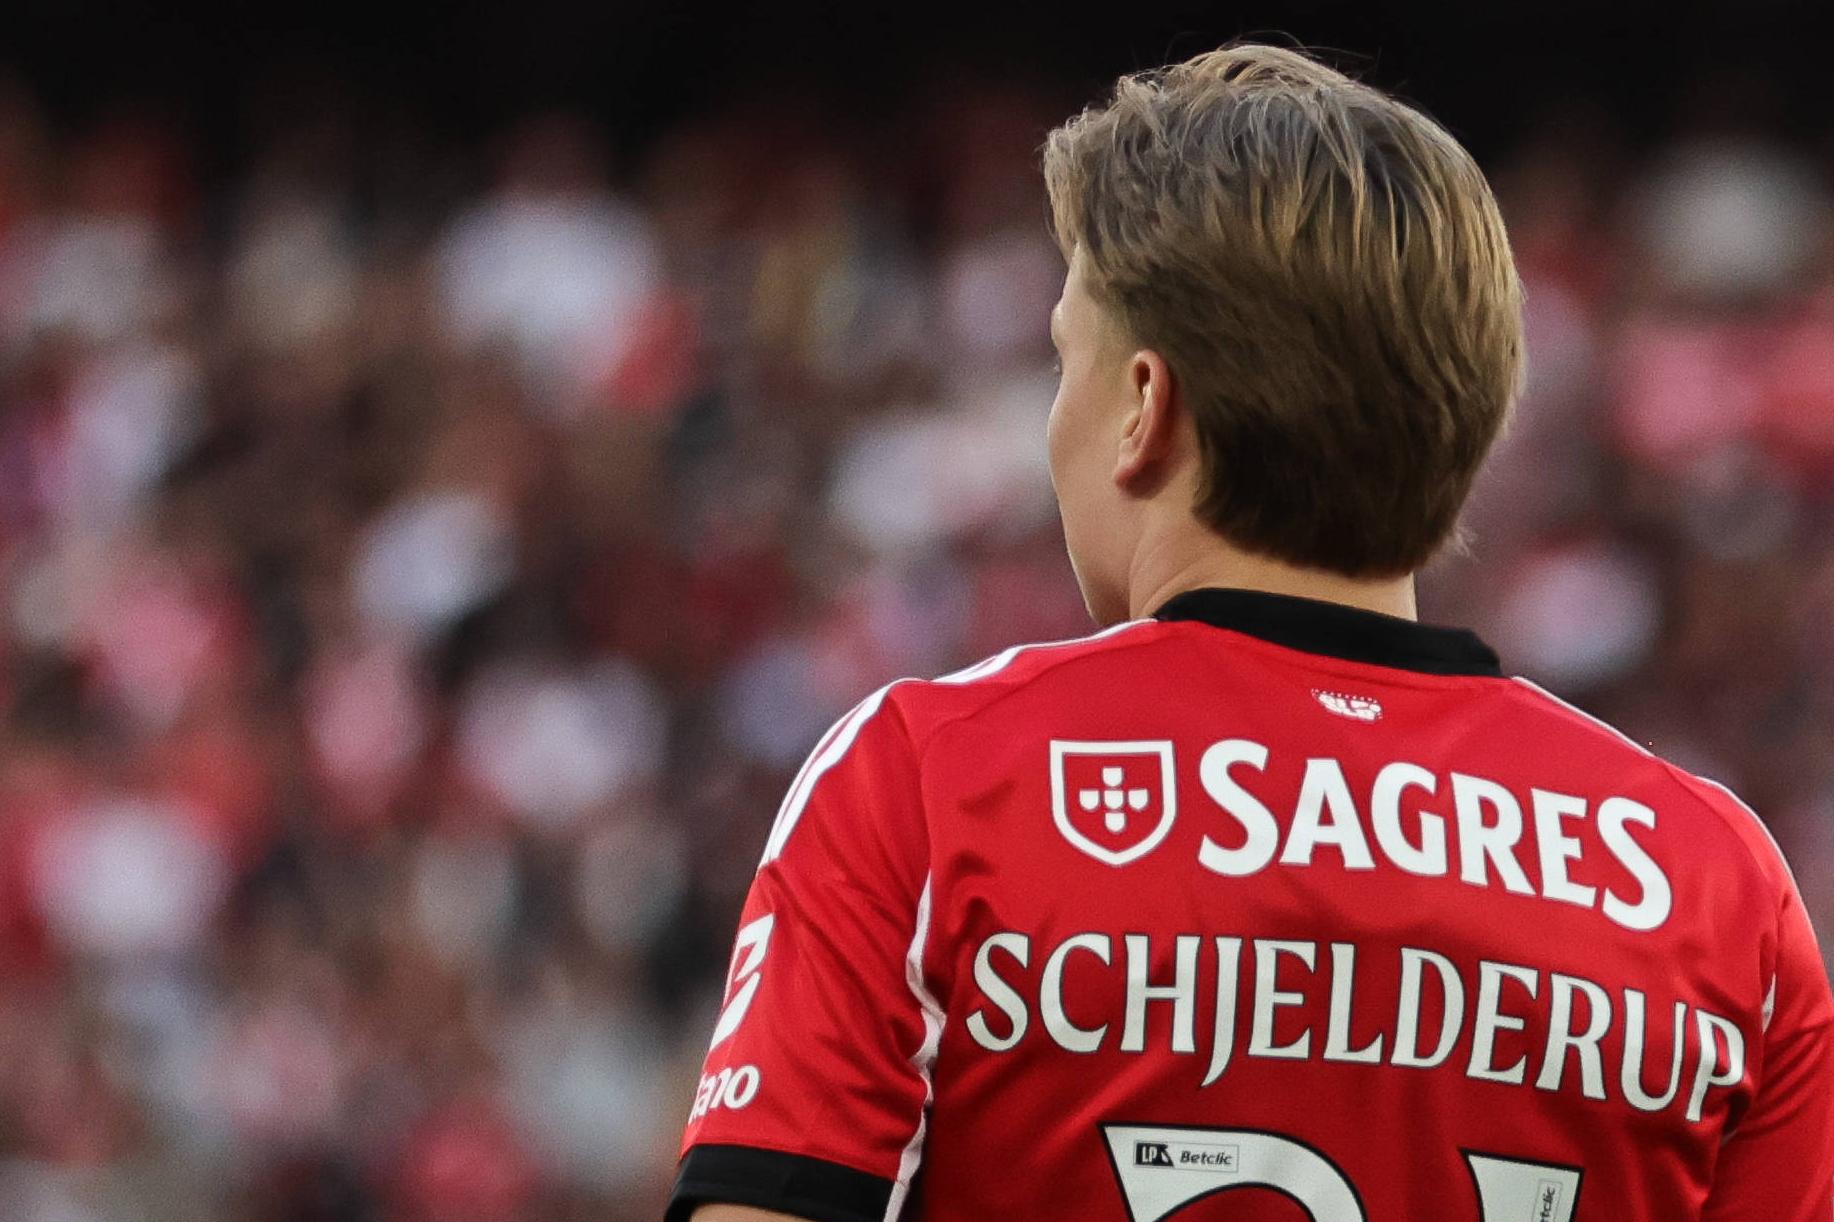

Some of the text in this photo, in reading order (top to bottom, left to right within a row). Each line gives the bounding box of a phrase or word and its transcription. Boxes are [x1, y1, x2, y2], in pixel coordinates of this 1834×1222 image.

[1199, 739, 1671, 931] SAGRES
[965, 933, 1745, 1122] SCHJELDERUP
[1179, 1150, 1233, 1166] Betclic
